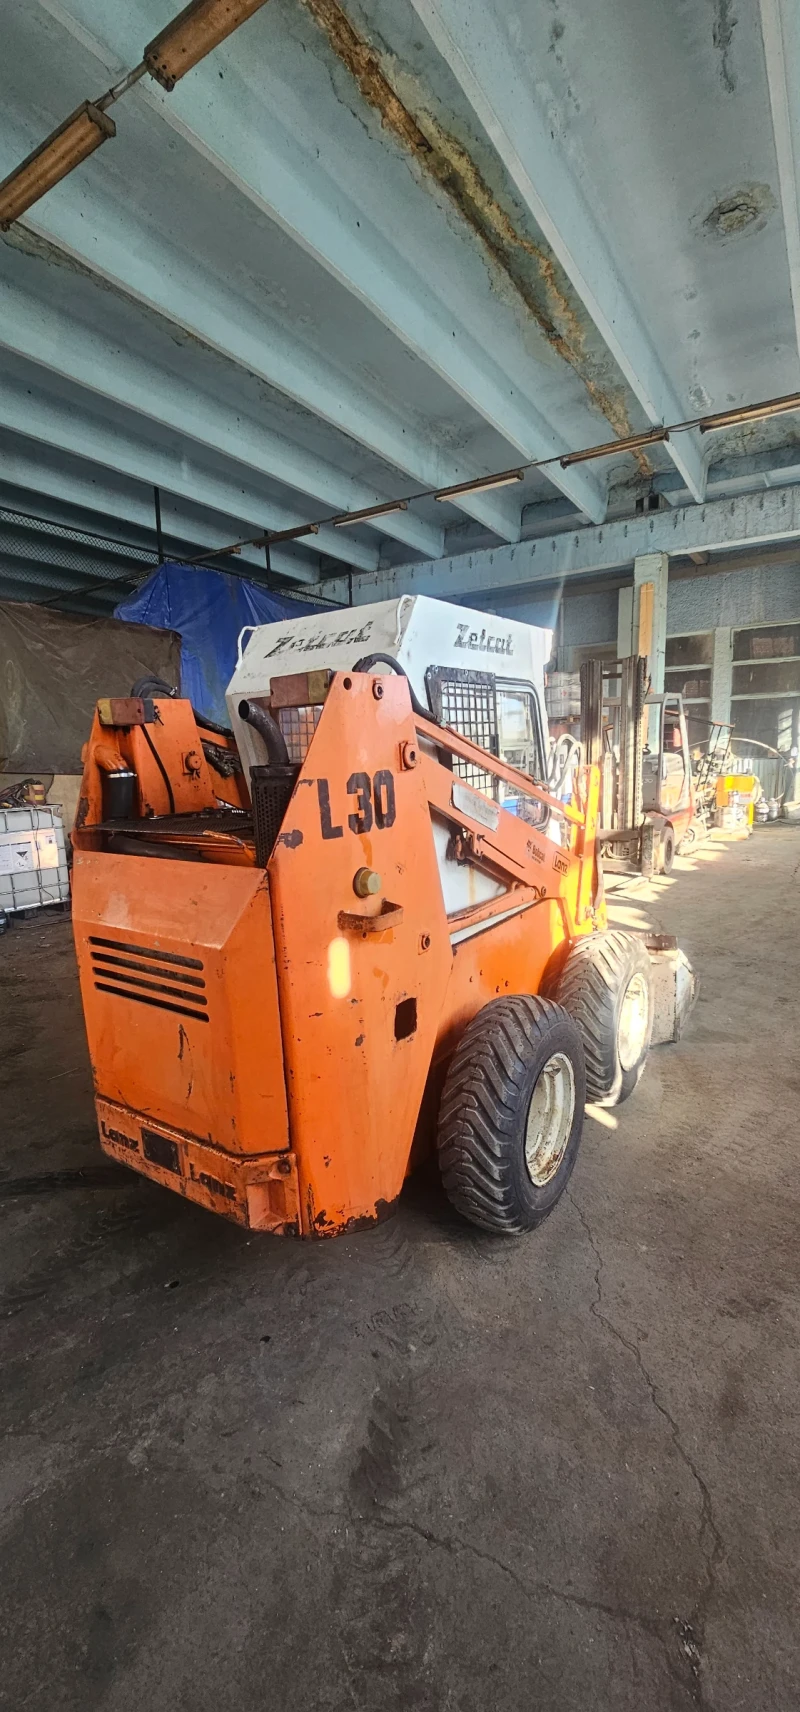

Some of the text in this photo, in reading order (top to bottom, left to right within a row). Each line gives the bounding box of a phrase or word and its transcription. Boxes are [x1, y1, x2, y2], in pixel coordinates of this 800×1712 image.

[317, 769, 396, 840] L30
[101, 1120, 139, 1151] Lanz
[189, 1162, 237, 1201] Lanz
